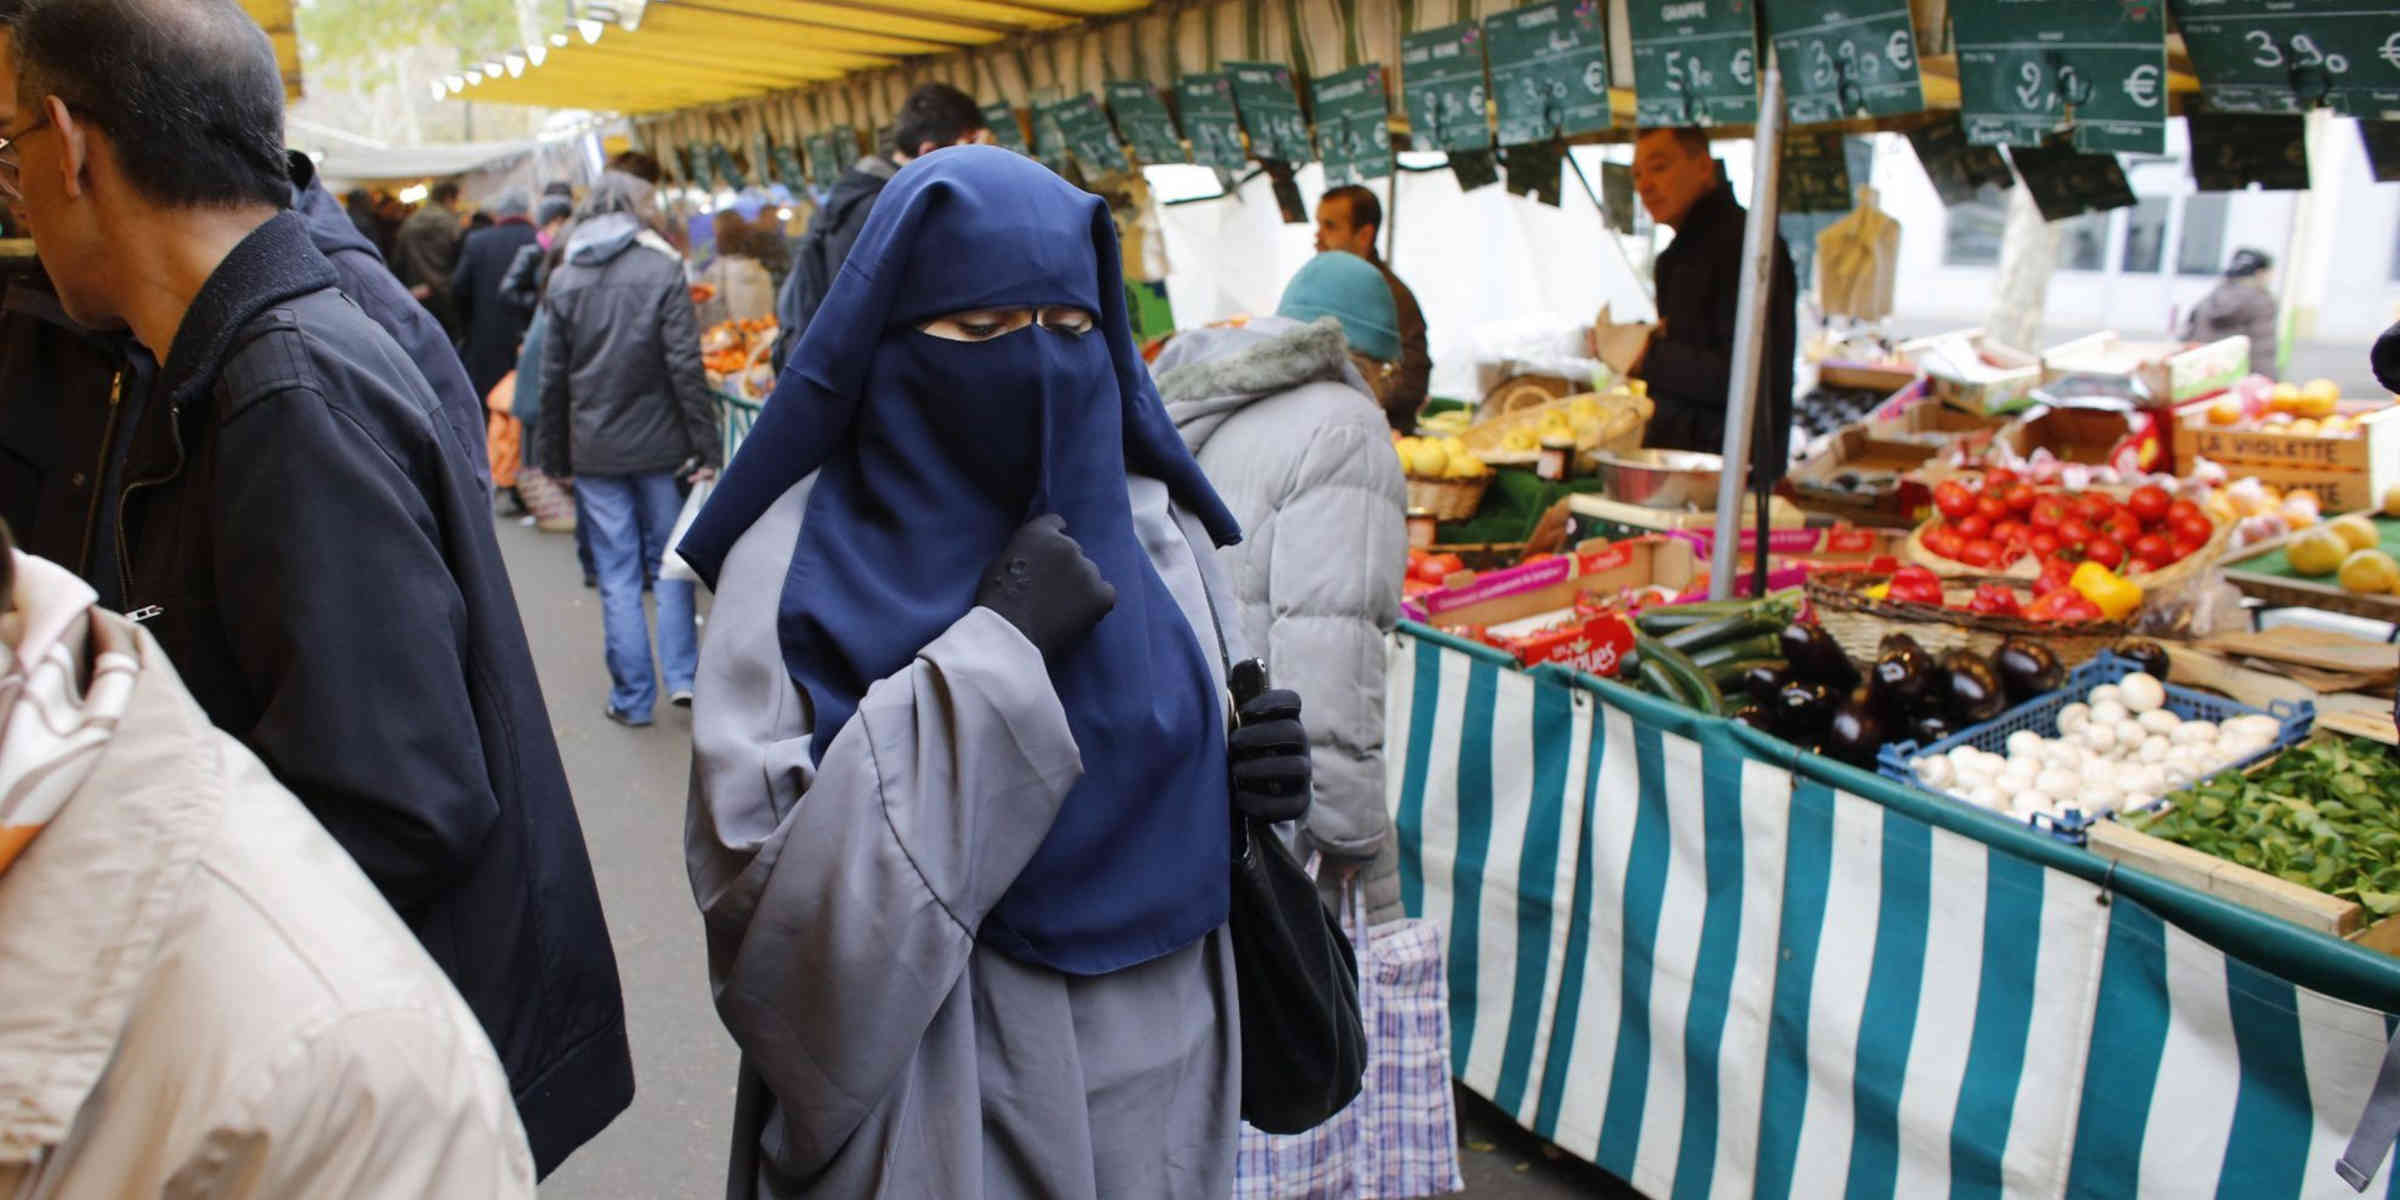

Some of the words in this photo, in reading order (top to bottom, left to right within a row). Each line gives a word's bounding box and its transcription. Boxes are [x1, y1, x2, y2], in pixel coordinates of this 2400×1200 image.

[1731, 48, 1752, 86] €
[1886, 29, 1913, 70] €
[2122, 64, 2159, 108] €
[2236, 437, 2339, 464] VIOLETTE
